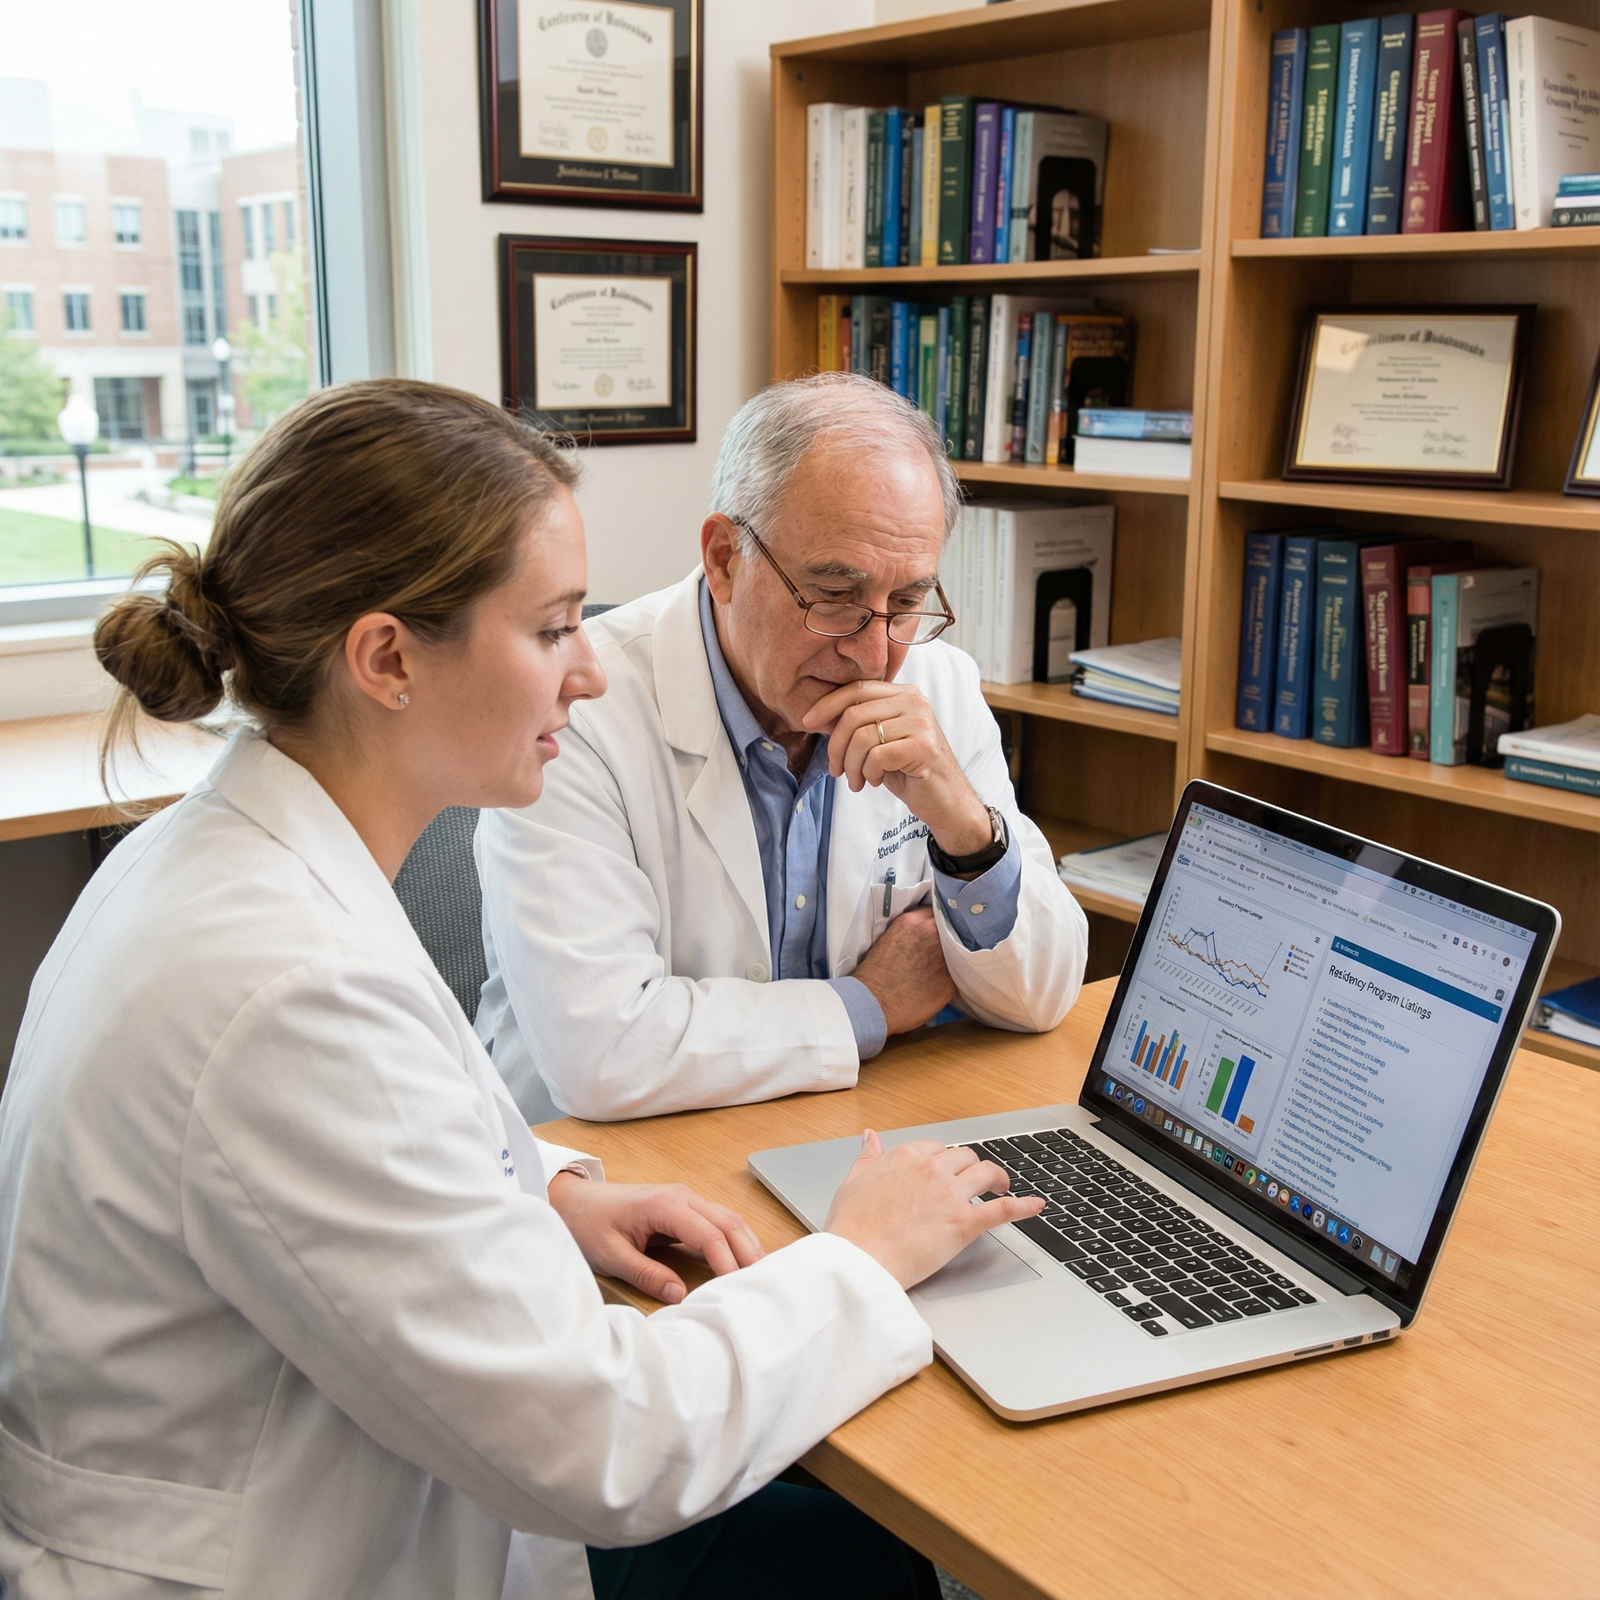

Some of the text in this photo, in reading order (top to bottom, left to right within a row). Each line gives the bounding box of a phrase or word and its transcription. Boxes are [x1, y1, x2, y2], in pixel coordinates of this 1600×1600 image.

[1328, 964, 1432, 1020] Residency Program Listings
